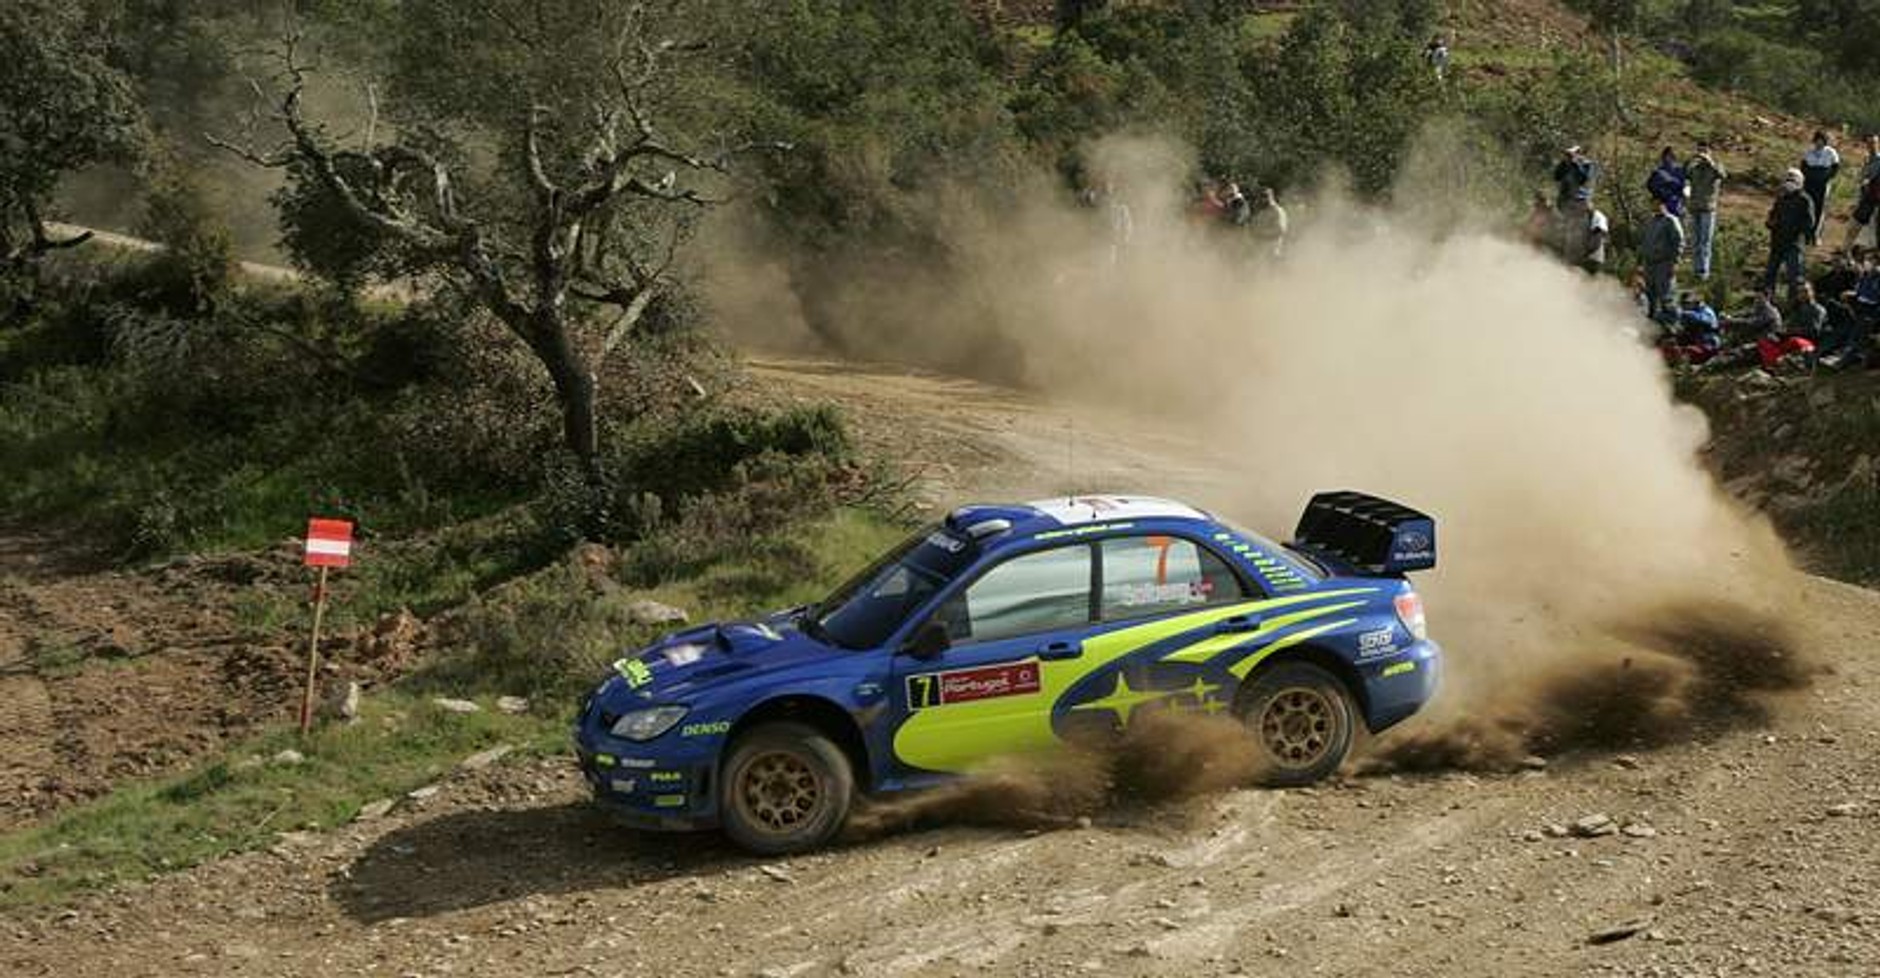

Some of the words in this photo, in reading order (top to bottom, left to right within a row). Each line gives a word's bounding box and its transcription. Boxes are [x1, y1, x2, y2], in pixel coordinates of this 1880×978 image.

[1145, 535, 1170, 586] 7
[916, 676, 931, 707] 7
[944, 677, 1011, 695] Portugal
[681, 721, 731, 737] DENSO
